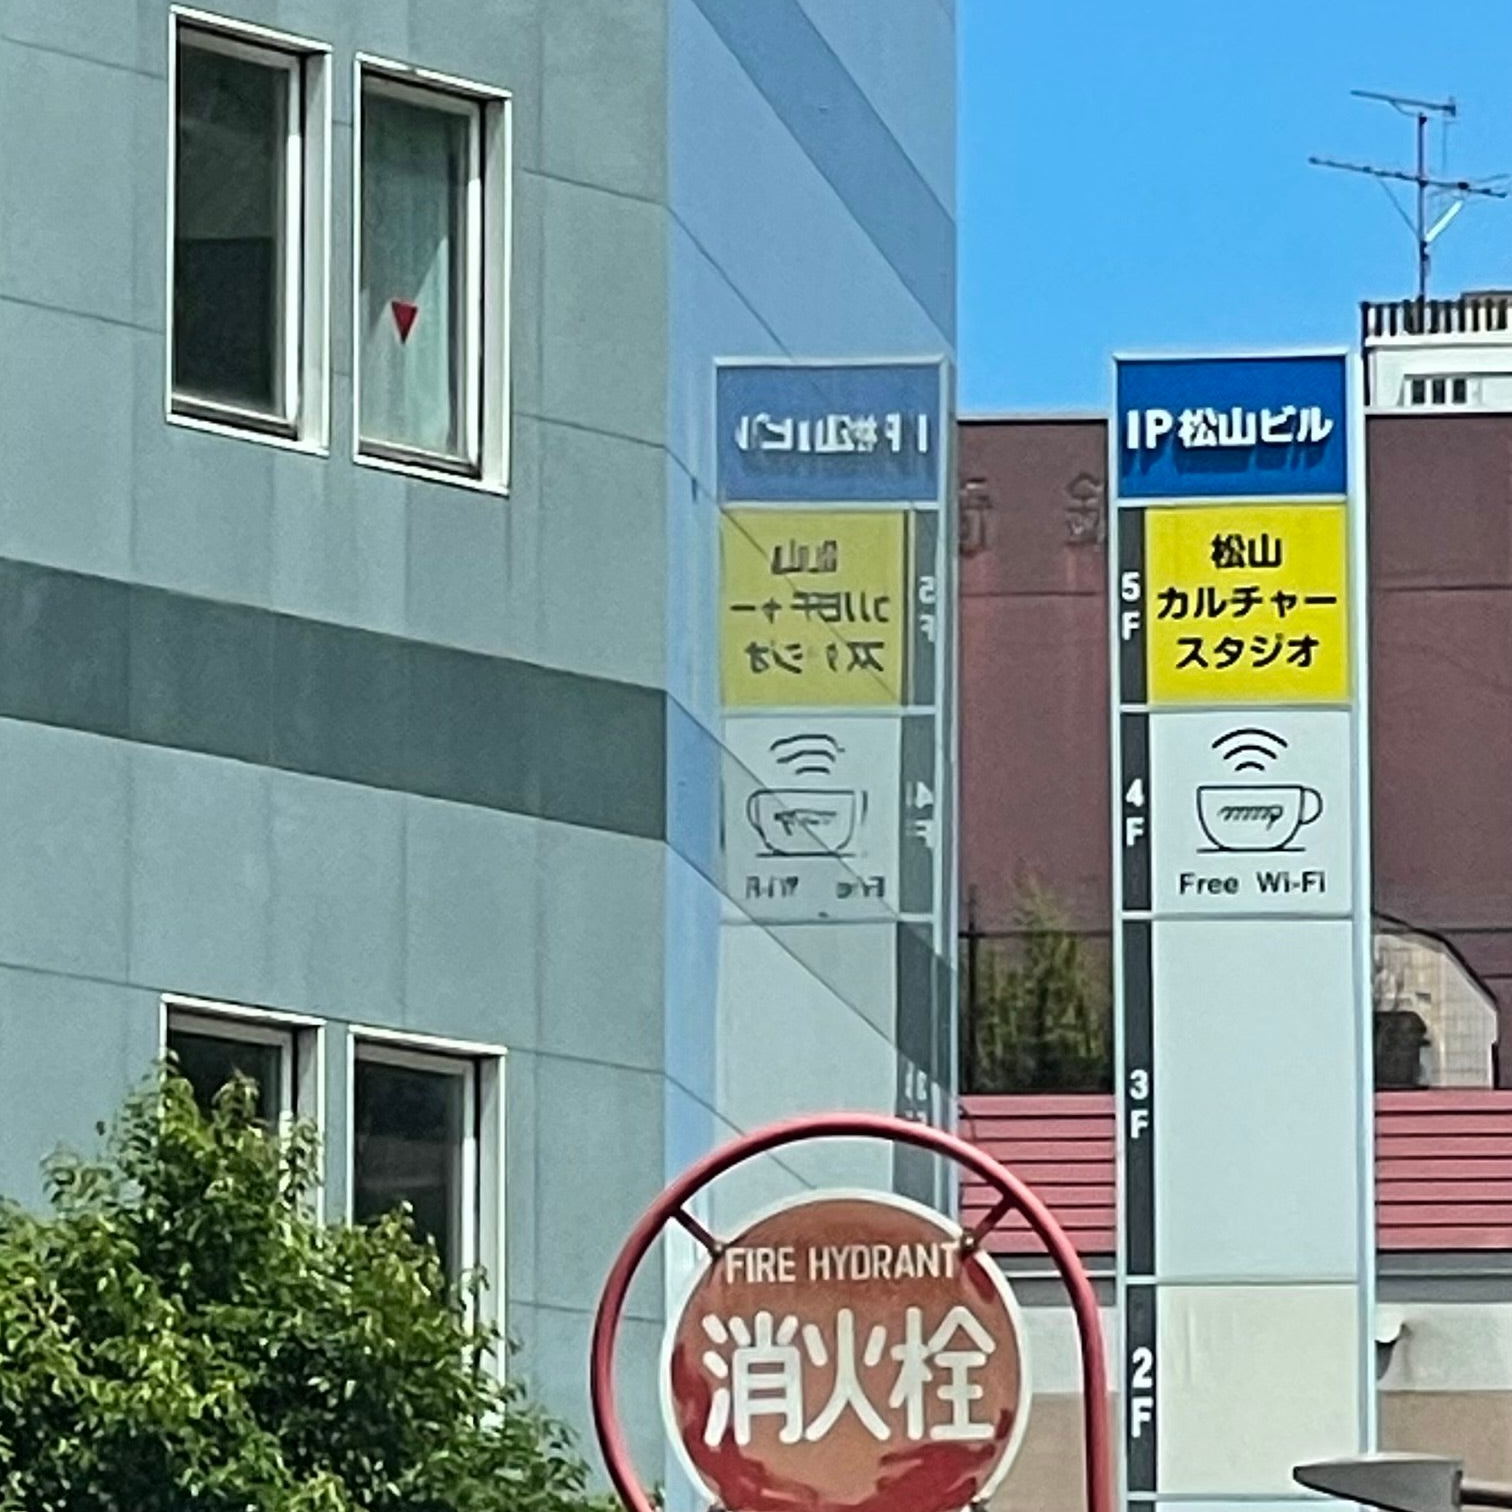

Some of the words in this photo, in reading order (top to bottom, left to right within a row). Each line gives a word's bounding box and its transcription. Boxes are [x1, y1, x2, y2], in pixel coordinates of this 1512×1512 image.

[1211, 533, 1282, 568] 松山
[1157, 586, 1337, 620] カルチャー
[1176, 633, 1319, 669] スタジオ
[1179, 871, 1239, 895] Free
[1256, 870, 1326, 894] Wi-Fi
[725, 1246, 797, 1284] FIRE
[808, 1240, 960, 1281] HYDRANT
[700, 1304, 997, 1447] 消火栓
